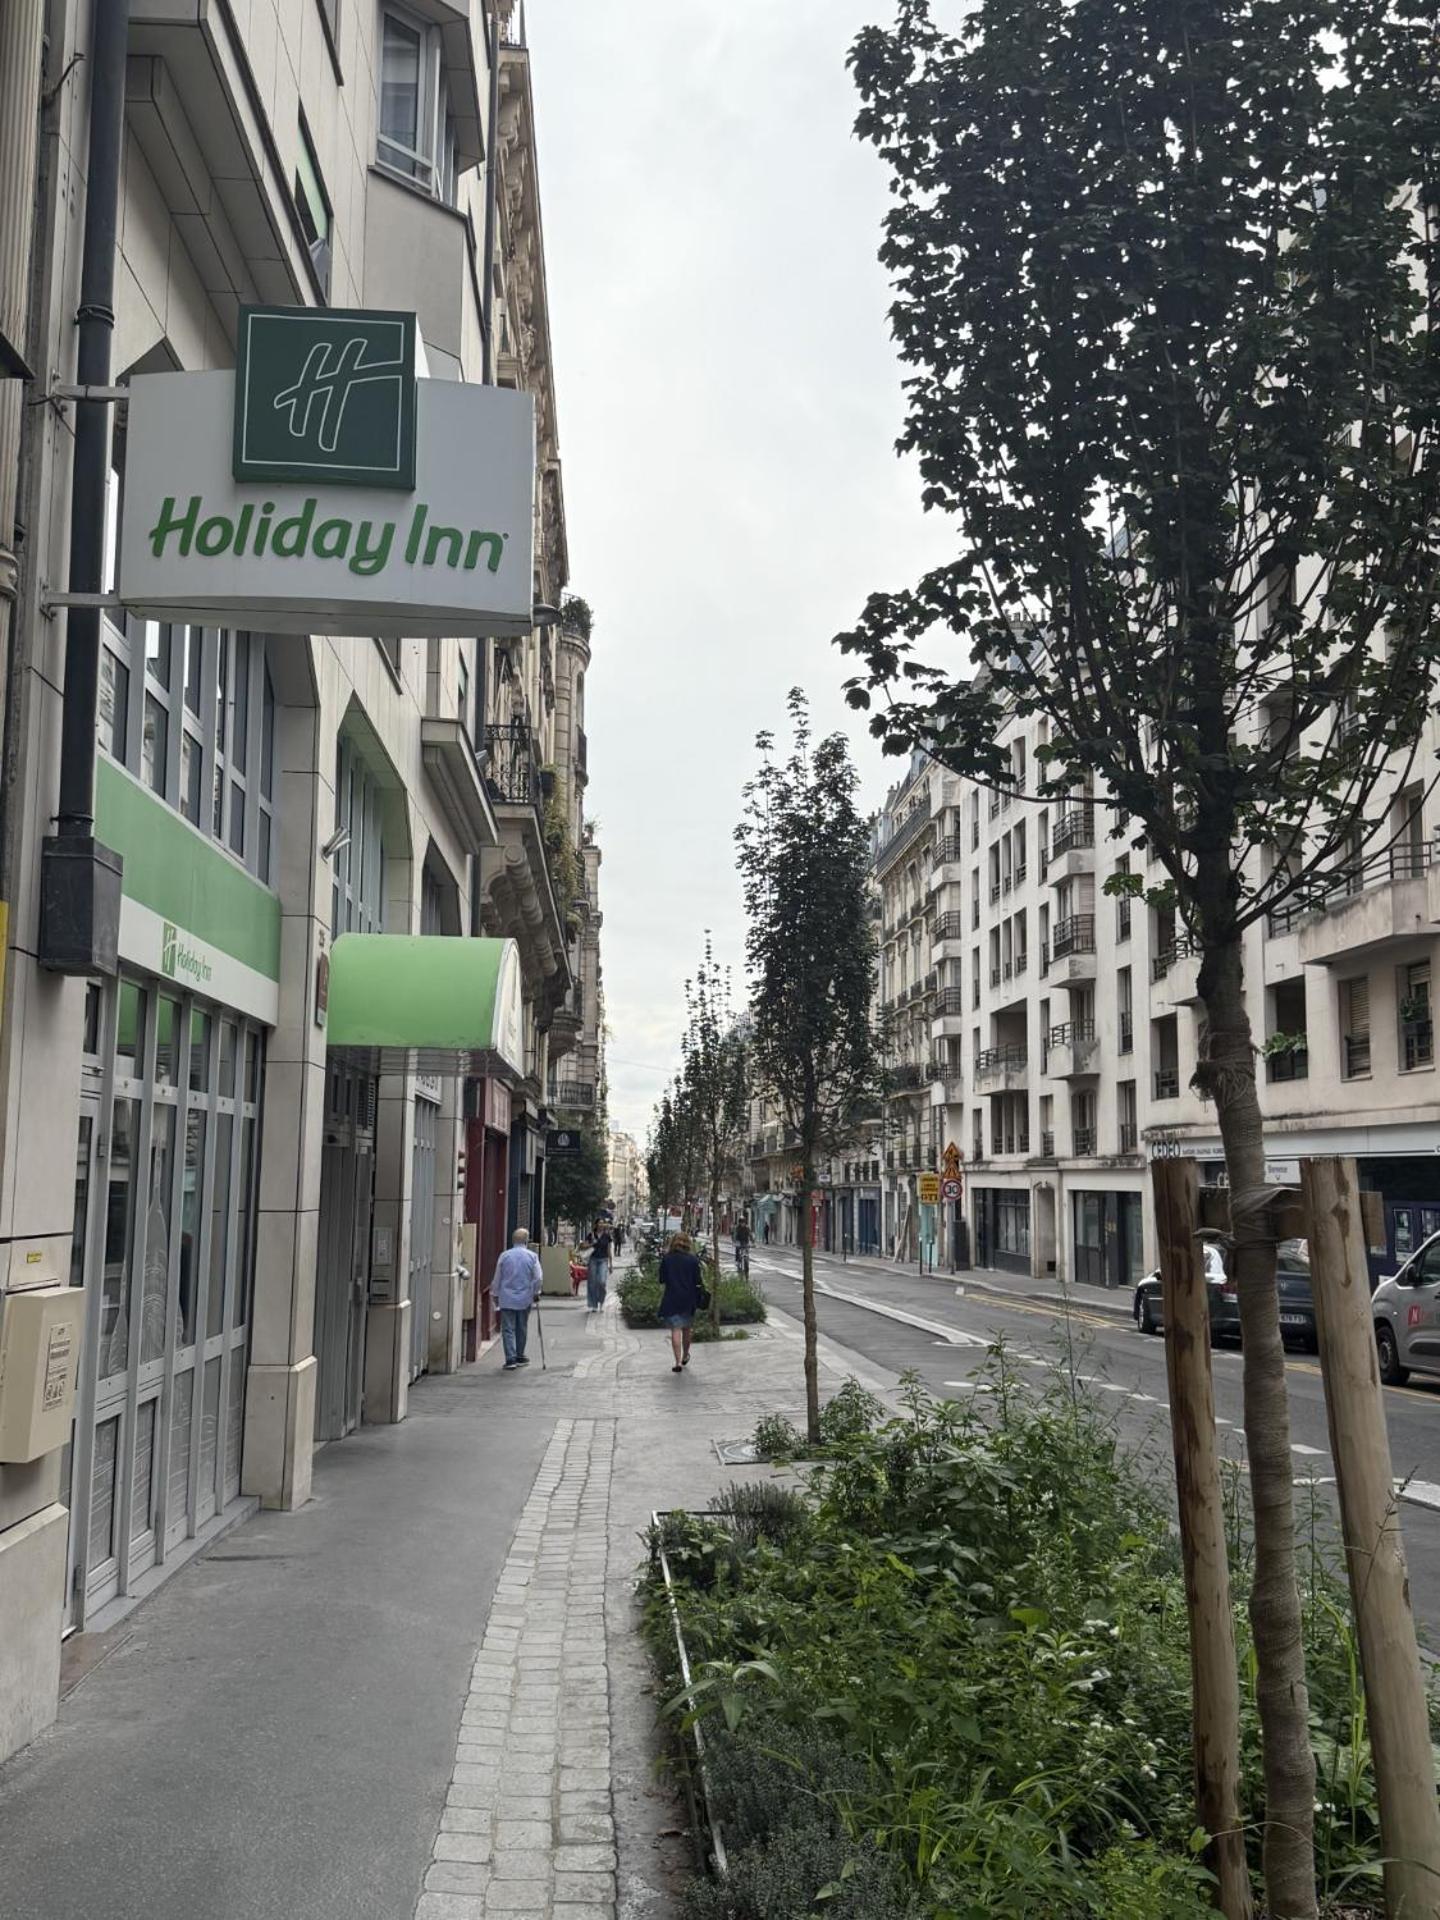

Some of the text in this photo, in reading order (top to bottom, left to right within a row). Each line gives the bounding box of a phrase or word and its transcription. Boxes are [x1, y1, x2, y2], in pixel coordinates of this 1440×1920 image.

[148, 495, 506, 576] Holiday Inn
[177, 943, 202, 982] Holiday
[946, 1184, 958, 1194] 30
